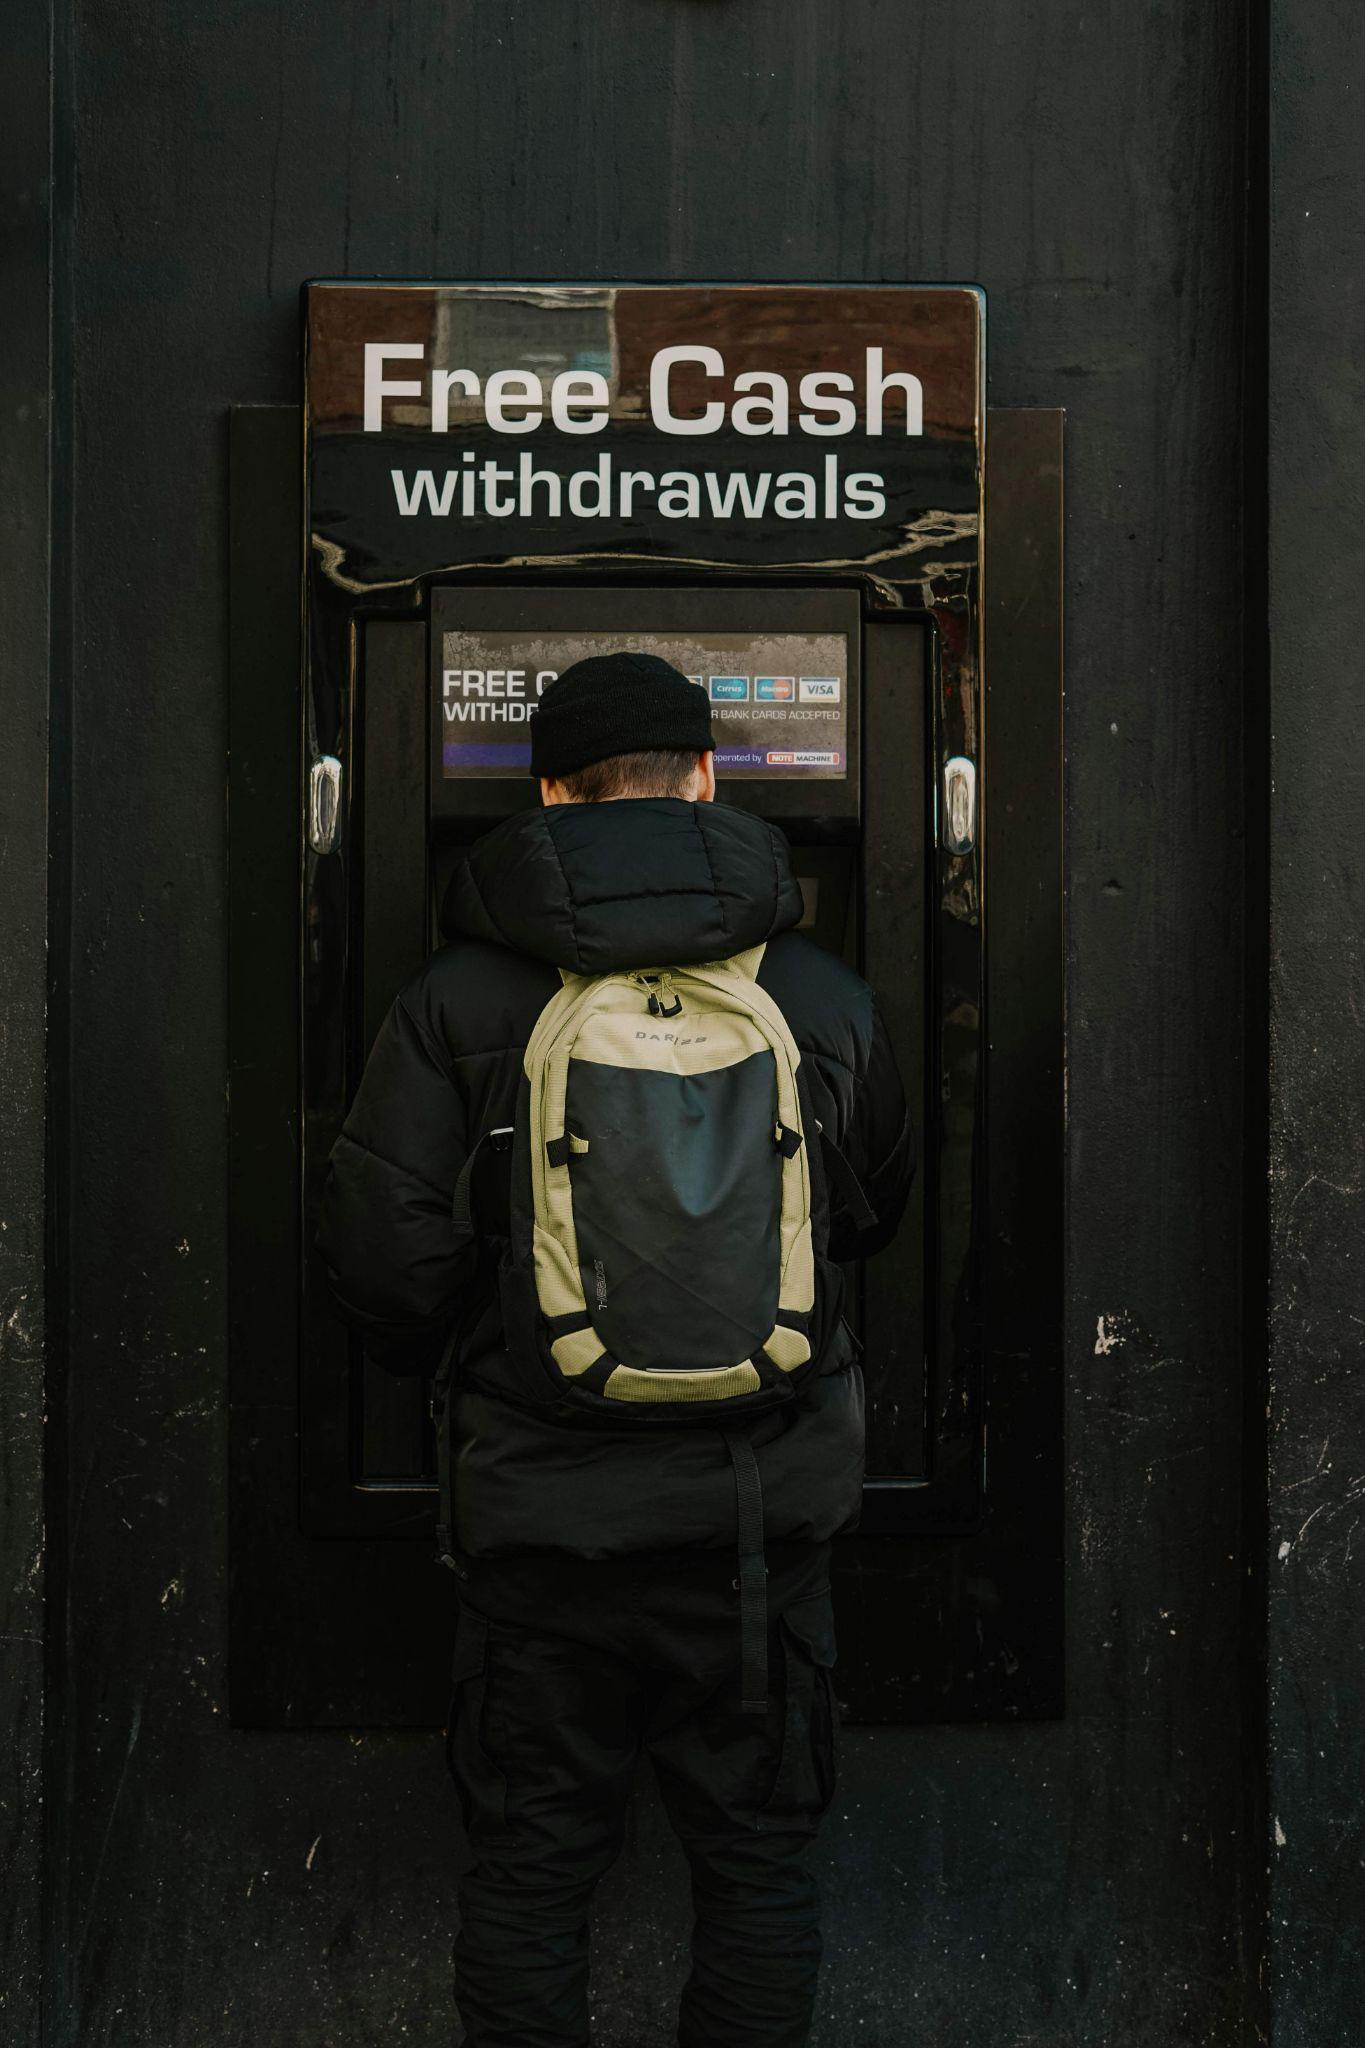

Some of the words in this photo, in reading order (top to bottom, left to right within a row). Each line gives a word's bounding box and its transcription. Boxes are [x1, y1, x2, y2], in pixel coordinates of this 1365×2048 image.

[362, 342, 610, 435] Free
[649, 345, 924, 437] Cash
[390, 451, 887, 520] withdrawals
[443, 670, 525, 697] FREE
[807, 685, 834, 695] VISA
[721, 710, 749, 719] BANK
[752, 710, 786, 719] CARDS
[789, 711, 841, 720] ACCEPTED
[712, 753, 750, 763] operated
[752, 753, 762, 763] by
